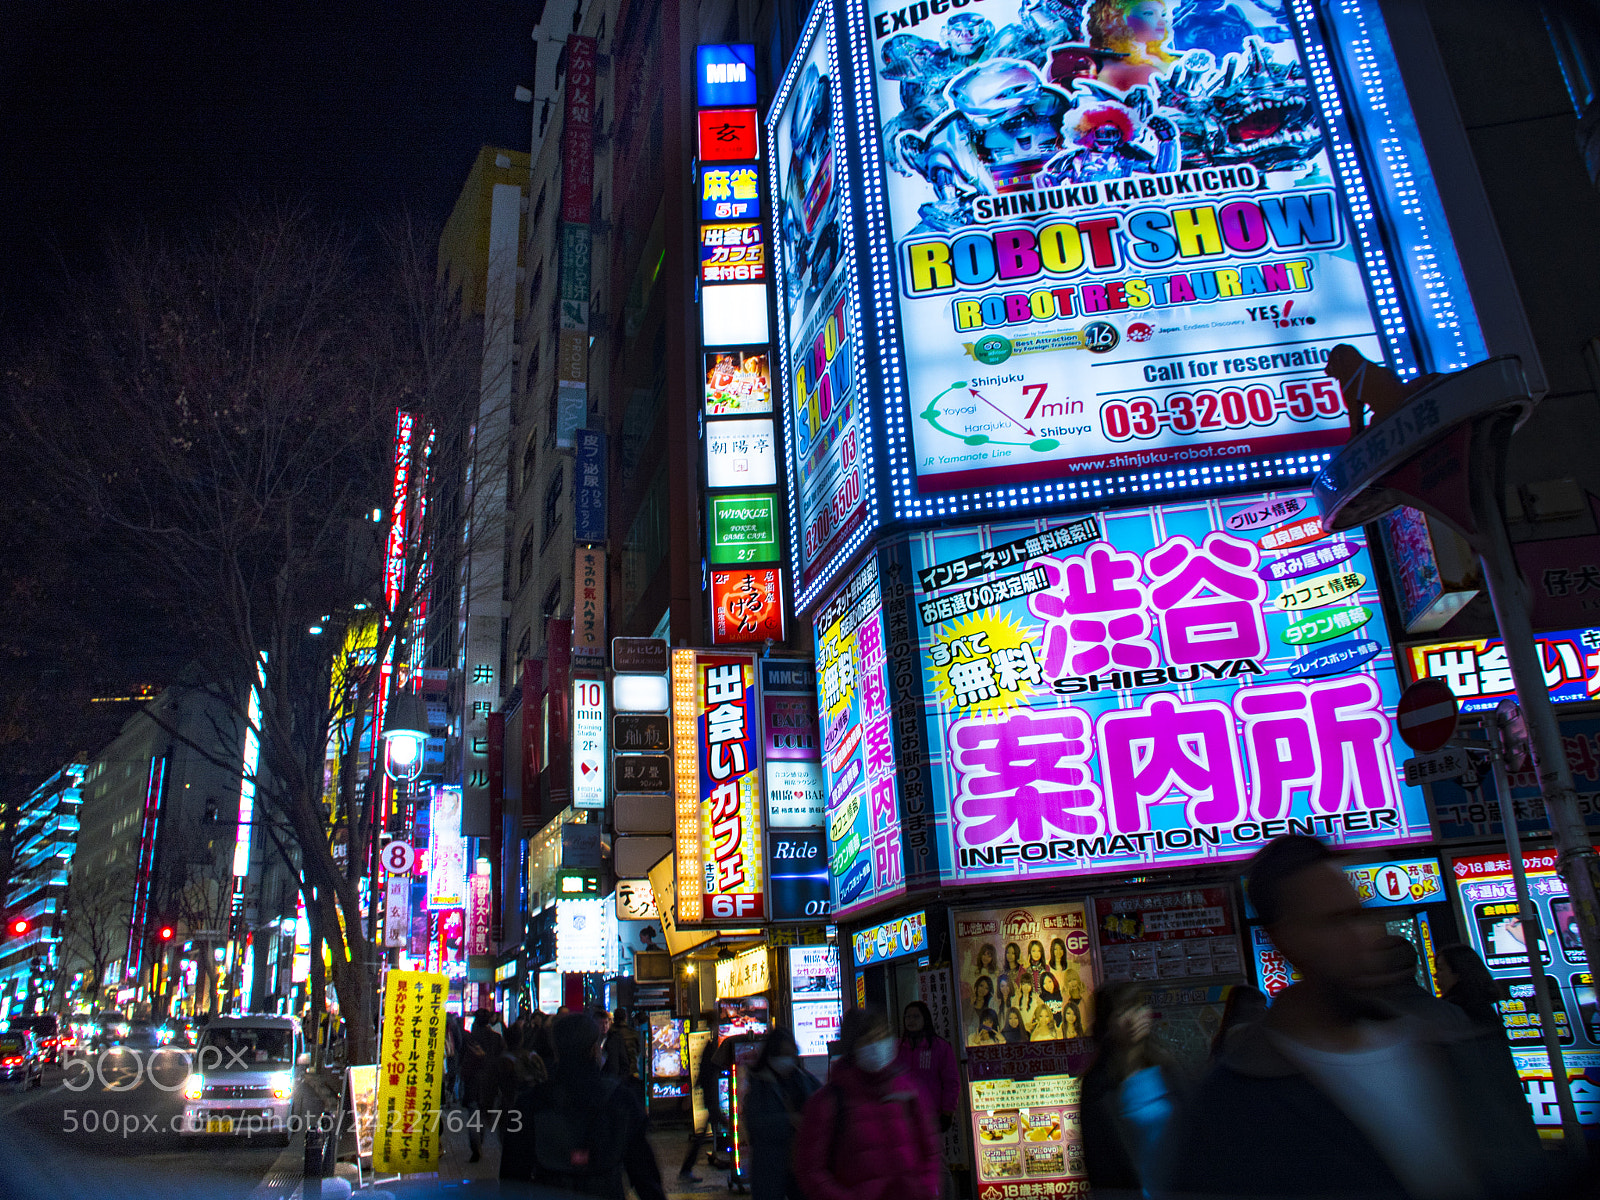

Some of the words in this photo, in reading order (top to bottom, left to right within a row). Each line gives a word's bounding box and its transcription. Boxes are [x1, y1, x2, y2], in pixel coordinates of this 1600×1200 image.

[706, 62, 747, 83] MM
[708, 122, 746, 142] 玄
[703, 168, 759, 201] 麻雀
[976, 184, 1097, 219] SHINJUKU
[1104, 167, 1258, 204] KABUKICHO
[714, 202, 748, 218] 5F
[704, 227, 761, 247] 出会い
[910, 217, 1119, 292] ROBOT
[1128, 192, 1335, 263] SHOW
[711, 246, 763, 264] カフェ
[703, 264, 765, 281] 受付6F
[957, 287, 1075, 330] ROBOT
[1082, 261, 1308, 313] RESTAURANT
[1183, 323, 1210, 331] Endless
[1210, 318, 1245, 329] Discovery
[796, 295, 846, 410] ROBOT
[1014, 339, 1034, 348] Best
[1034, 333, 1078, 345] Attraction
[1023, 343, 1049, 352] Foreign
[1050, 338, 1082, 349] Travelers
[971, 373, 1025, 388] Shinjuku
[1143, 361, 1186, 383] Call
[1187, 357, 1218, 378] for
[798, 346, 850, 451] SHOW
[942, 404, 977, 416] Yoyogi
[1021, 383, 1049, 420] 7
[1041, 397, 1085, 418] min
[964, 419, 1012, 434] Harajuku
[1039, 424, 1092, 439] Shibuya
[709, 439, 769, 456] 朝陽亭
[841, 427, 858, 471] 03
[922, 457, 936, 467] JR
[937, 450, 989, 466] Yamanote
[991, 448, 1013, 459] Line
[1068, 442, 1252, 473] www.shinjuku-robot.com
[718, 508, 769, 520] WINKLE
[805, 468, 861, 560] 3200-5500
[1230, 498, 1301, 529] グルメ情報
[722, 532, 745, 542] GAME
[730, 524, 757, 532] POKER
[1260, 520, 1323, 549] 優良風俗
[737, 549, 757, 561] 2F
[922, 519, 1098, 588] インターネット無料検索!!
[1270, 544, 1350, 579] 飲み屋情報
[715, 574, 729, 585] 2F
[763, 571, 777, 603] 居酒屋
[1280, 573, 1361, 609] カフェ情報
[729, 573, 764, 634] まるげん
[922, 567, 1048, 624] お店選びの決定版!!
[1028, 531, 1266, 681] 渋谷
[1286, 607, 1368, 643] タウン情報
[819, 633, 839, 672] すべて
[930, 631, 991, 667] すべて
[824, 644, 856, 711] 無料
[948, 641, 1043, 707] 無料
[1052, 658, 1265, 695] SHIBUYA
[578, 683, 601, 707] 10
[472, 664, 494, 787] 井門ビル
[577, 709, 602, 720] min
[577, 724, 602, 733] Training
[886, 584, 929, 856] 18歳未満の方の入場はお断り致します。
[582, 740, 595, 750] 2F
[773, 733, 817, 749] DOLL
[859, 613, 902, 891] 無料案内所
[949, 674, 1391, 847] 案内所
[1408, 755, 1461, 781] 自転車を除く
[704, 662, 749, 892] 出会いカフェ
[770, 789, 793, 801] 相席
[773, 841, 818, 860] Ride
[959, 826, 1220, 868] INFORMATION
[1232, 807, 1400, 843] CENTER
[389, 845, 406, 870] 8
[1408, 864, 1434, 877] 充電
[1468, 856, 1554, 874] 18歳未の方の
[705, 862, 716, 893] キラリ
[1410, 879, 1436, 897] OK
[389, 882, 402, 941] 道玄坂
[711, 894, 755, 918] 6F
[430, 912, 440, 941] ワイン
[863, 930, 875, 945] トイレ
[885, 923, 898, 940] タバコ
[910, 915, 923, 930] 充電
[888, 936, 898, 956] OK
[912, 928, 923, 949] OK
[1067, 936, 1089, 950] 6F
[387, 980, 408, 1086] 見かけたらすぐ110番
